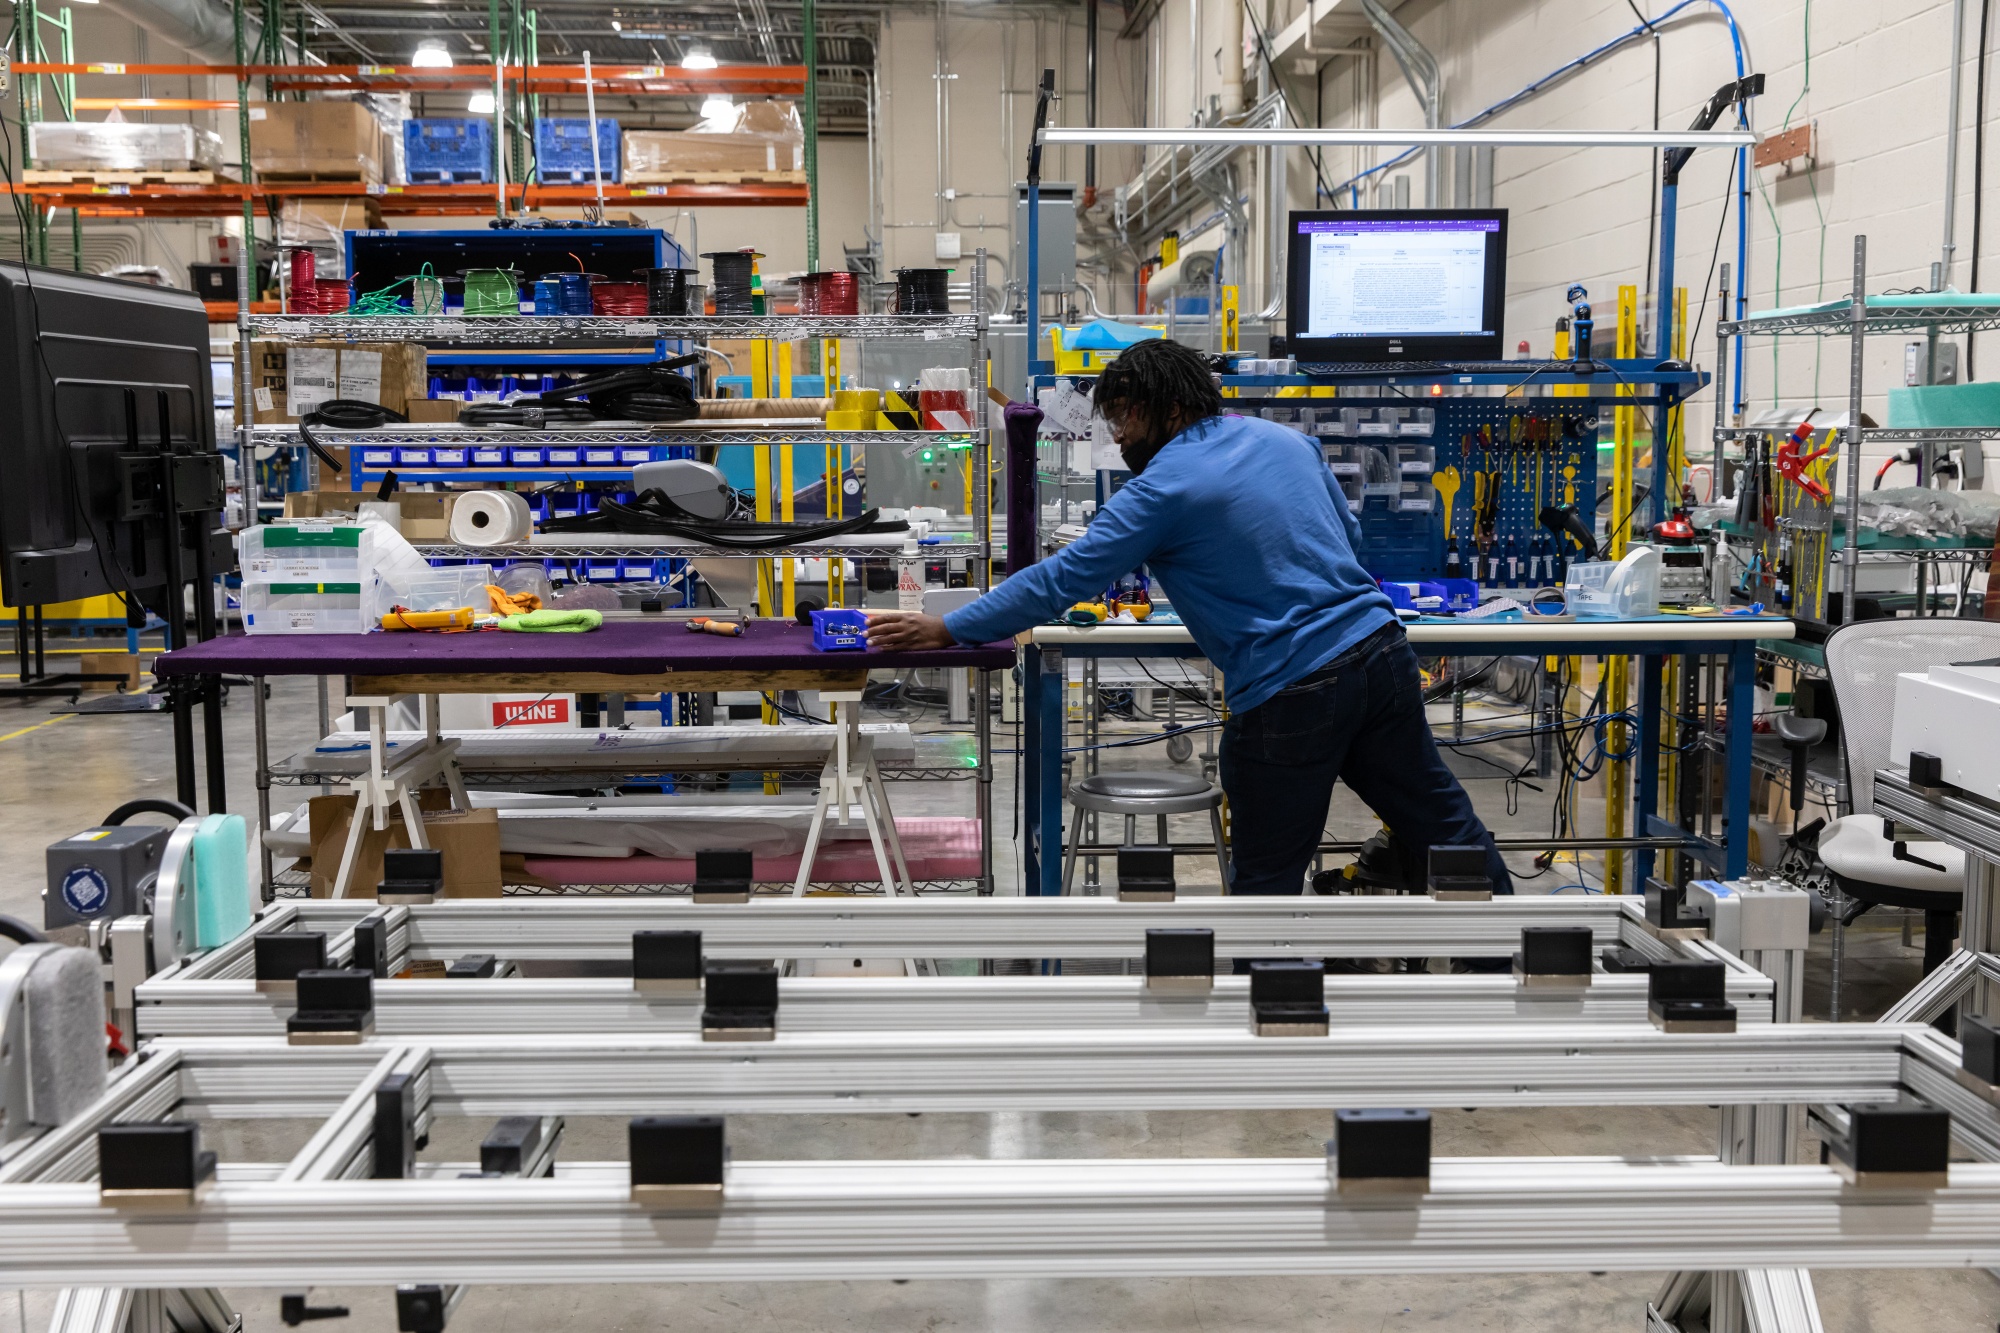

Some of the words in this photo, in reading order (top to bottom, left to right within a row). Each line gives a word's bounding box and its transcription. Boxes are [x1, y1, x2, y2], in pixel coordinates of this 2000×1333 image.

[907, 443, 928, 456] TAPES
[1577, 592, 1593, 601] TAPE
[505, 704, 557, 722] ULINE
